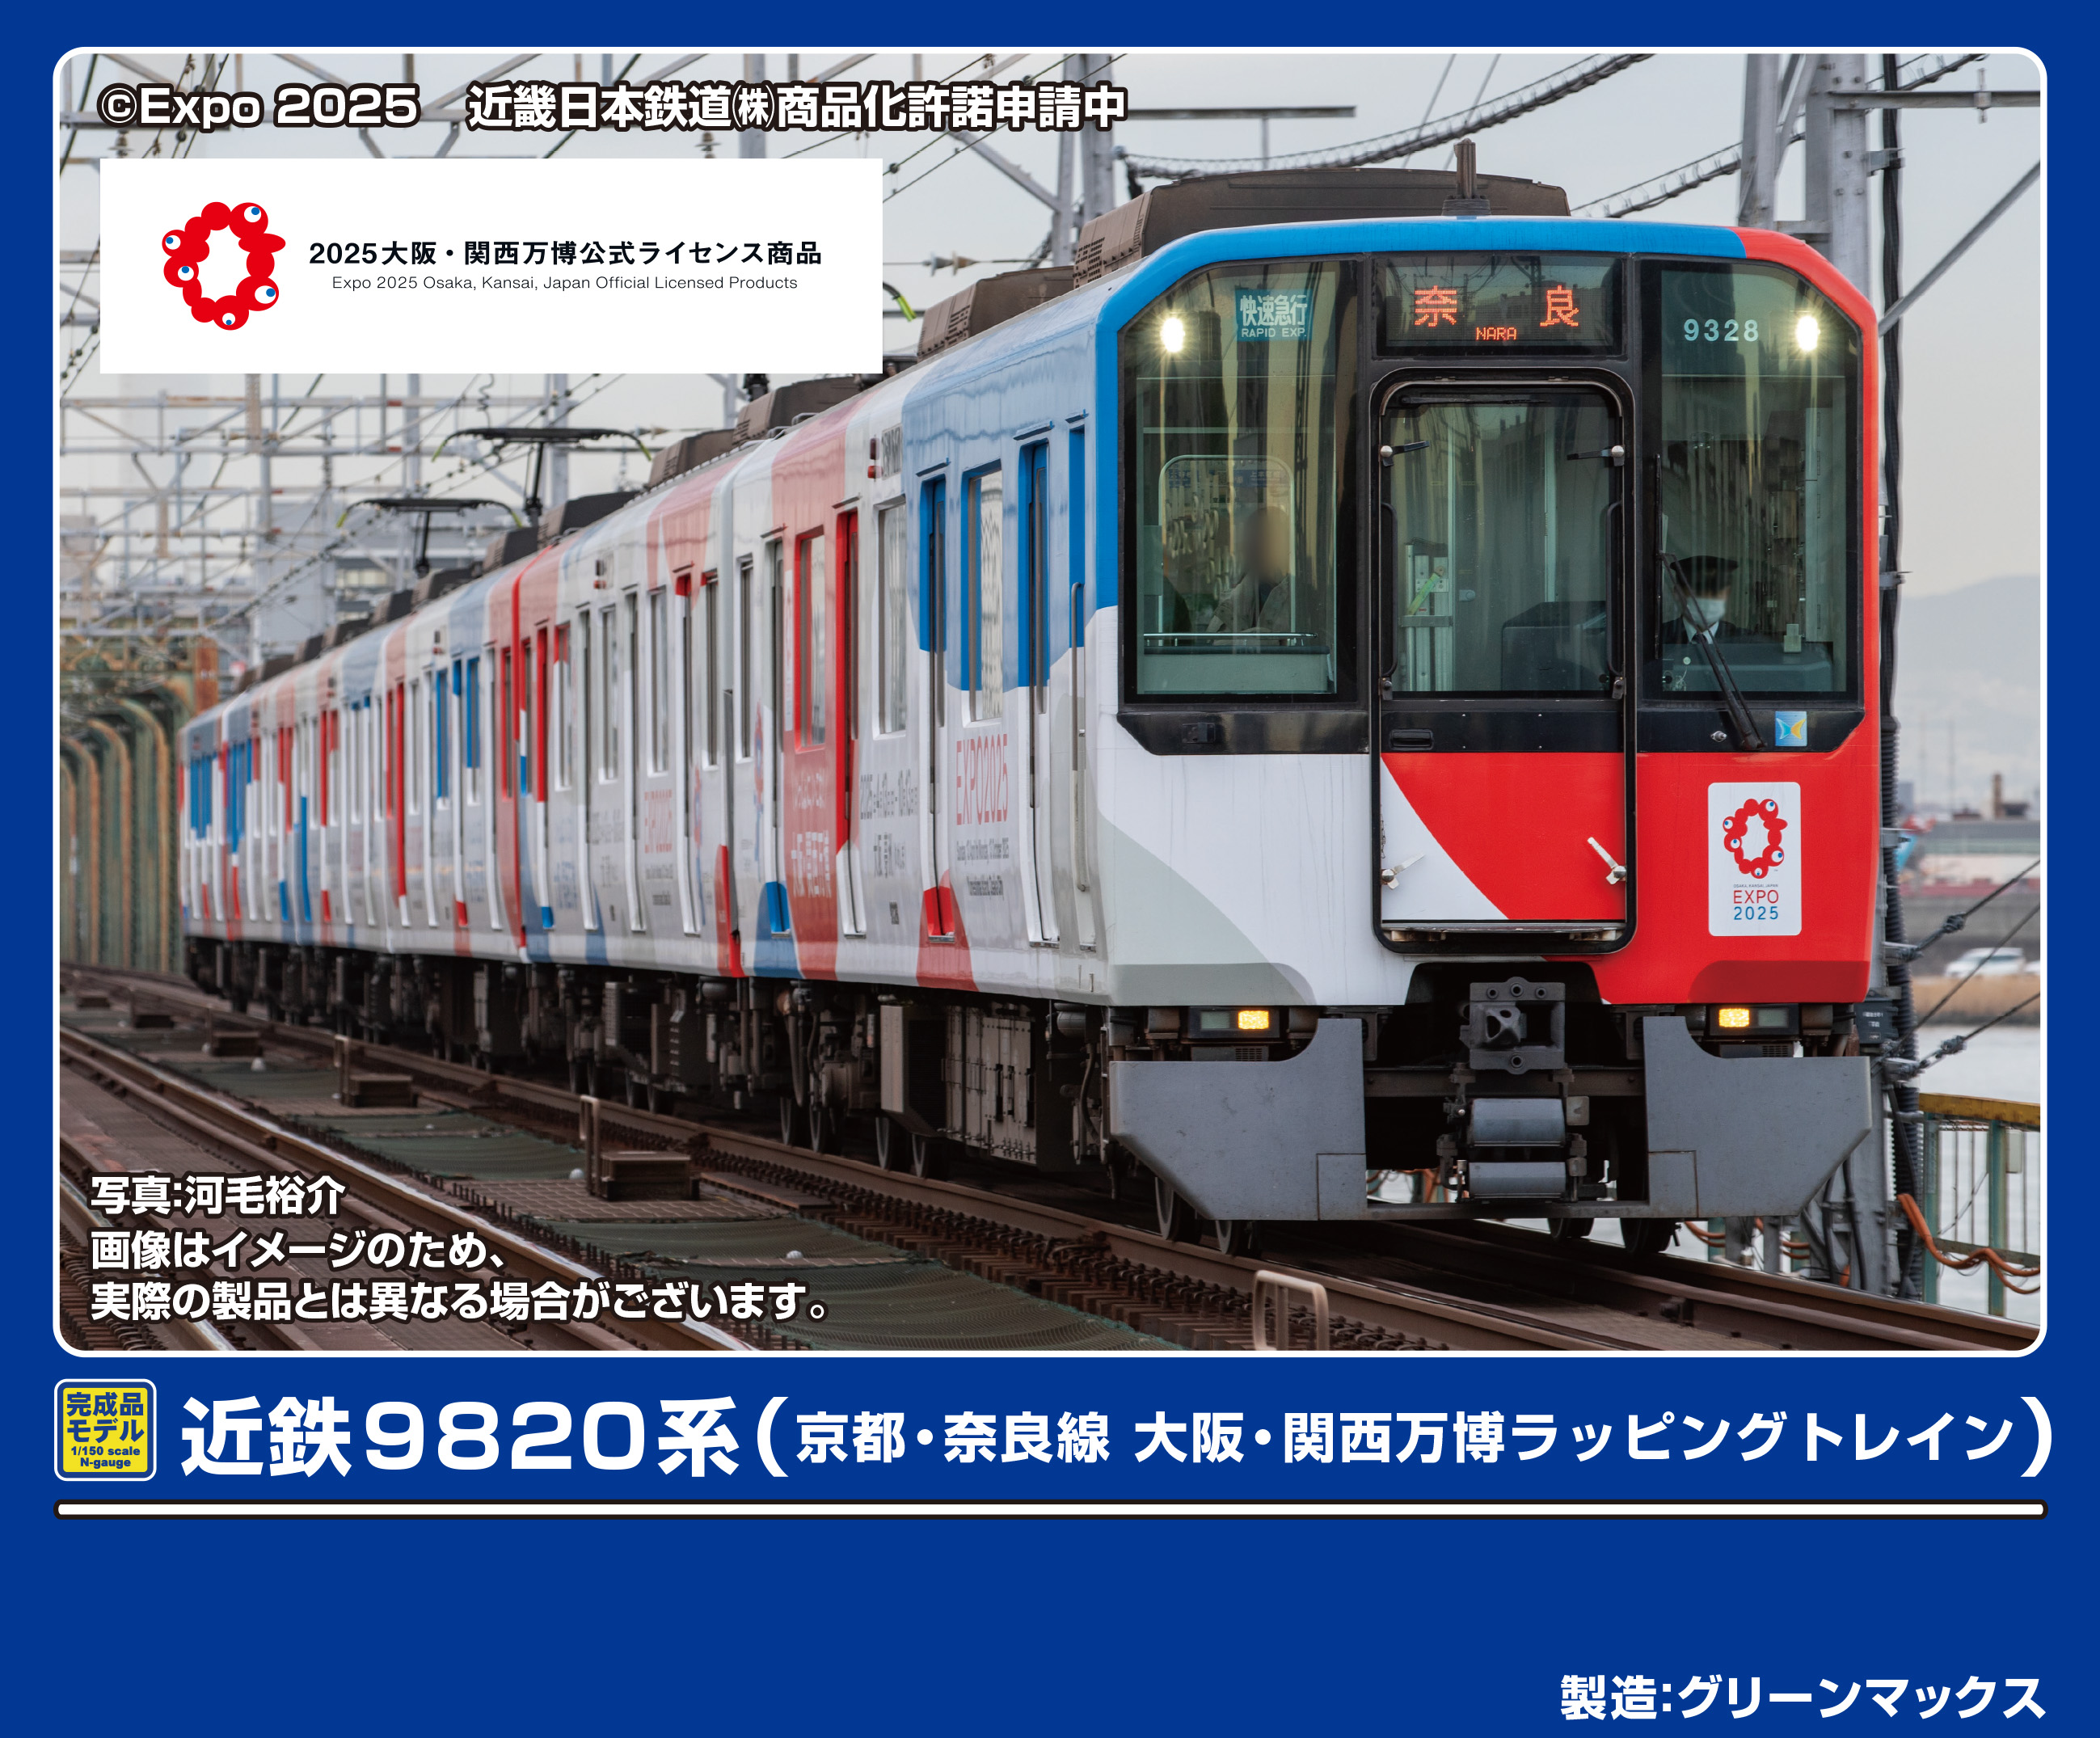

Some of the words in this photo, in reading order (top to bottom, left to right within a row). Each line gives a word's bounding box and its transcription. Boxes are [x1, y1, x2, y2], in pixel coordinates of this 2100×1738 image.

[1240, 294, 1308, 326] 快速急行
[1242, 328, 1276, 337] RAPID
[1282, 328, 1307, 337] EXP.
[1476, 327, 1517, 341] NARA
[1684, 318, 1759, 342] 9328
[955, 733, 1009, 825] EXPO2025
[1733, 889, 1779, 904] EXPO
[1734, 906, 1778, 920] 2025
